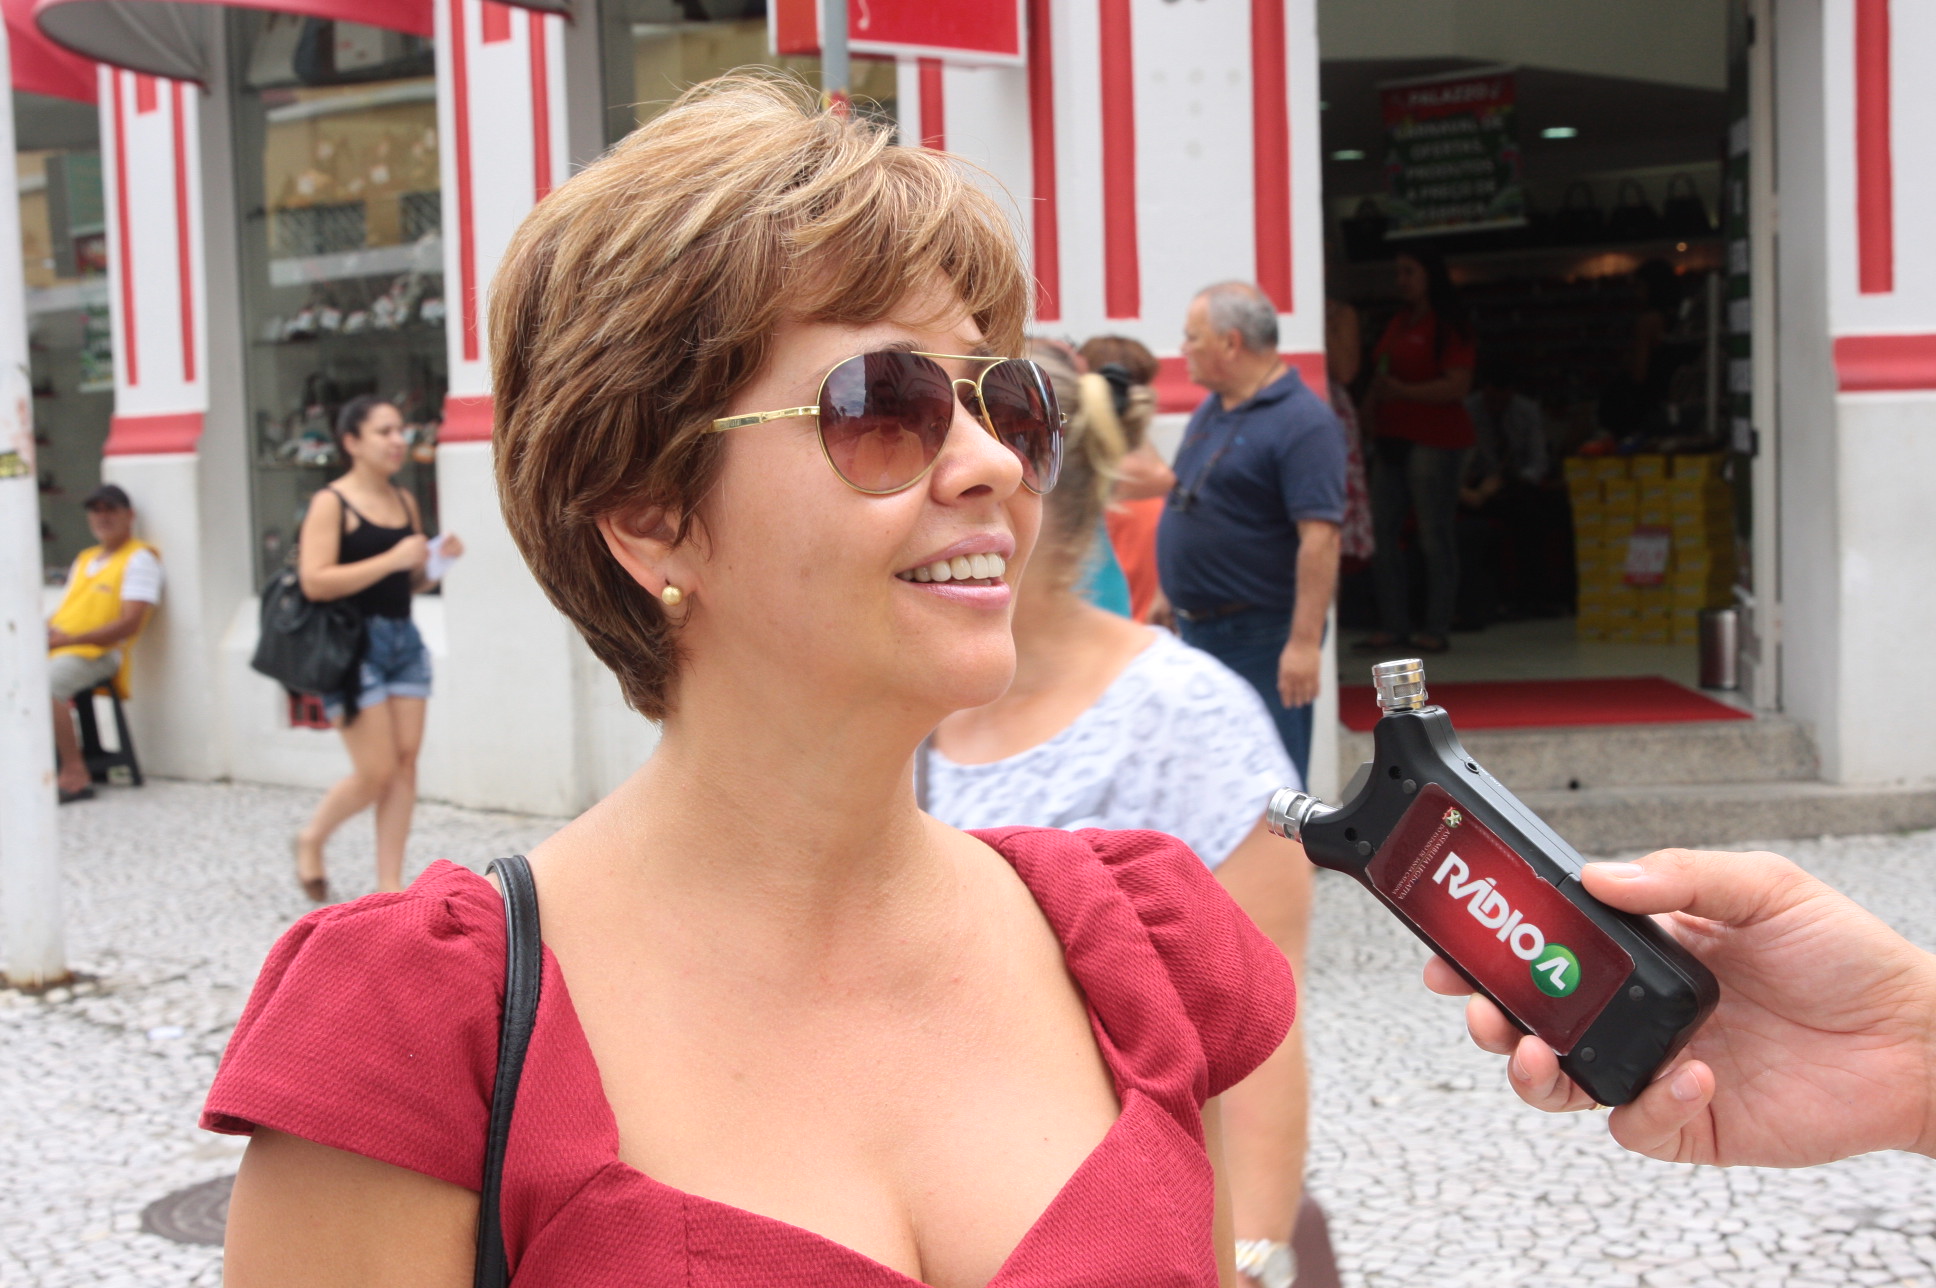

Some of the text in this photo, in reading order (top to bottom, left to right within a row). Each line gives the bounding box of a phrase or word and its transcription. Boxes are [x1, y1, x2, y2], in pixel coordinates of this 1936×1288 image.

[1422, 831, 1439, 851] ESTADO
[1398, 829, 1450, 900] ASSEMBLEIA LEGISLATIVA
[1407, 856, 1421, 872] SANTA
[1391, 871, 1410, 895] CATARINA
[1432, 851, 1545, 960] RÁDIO
